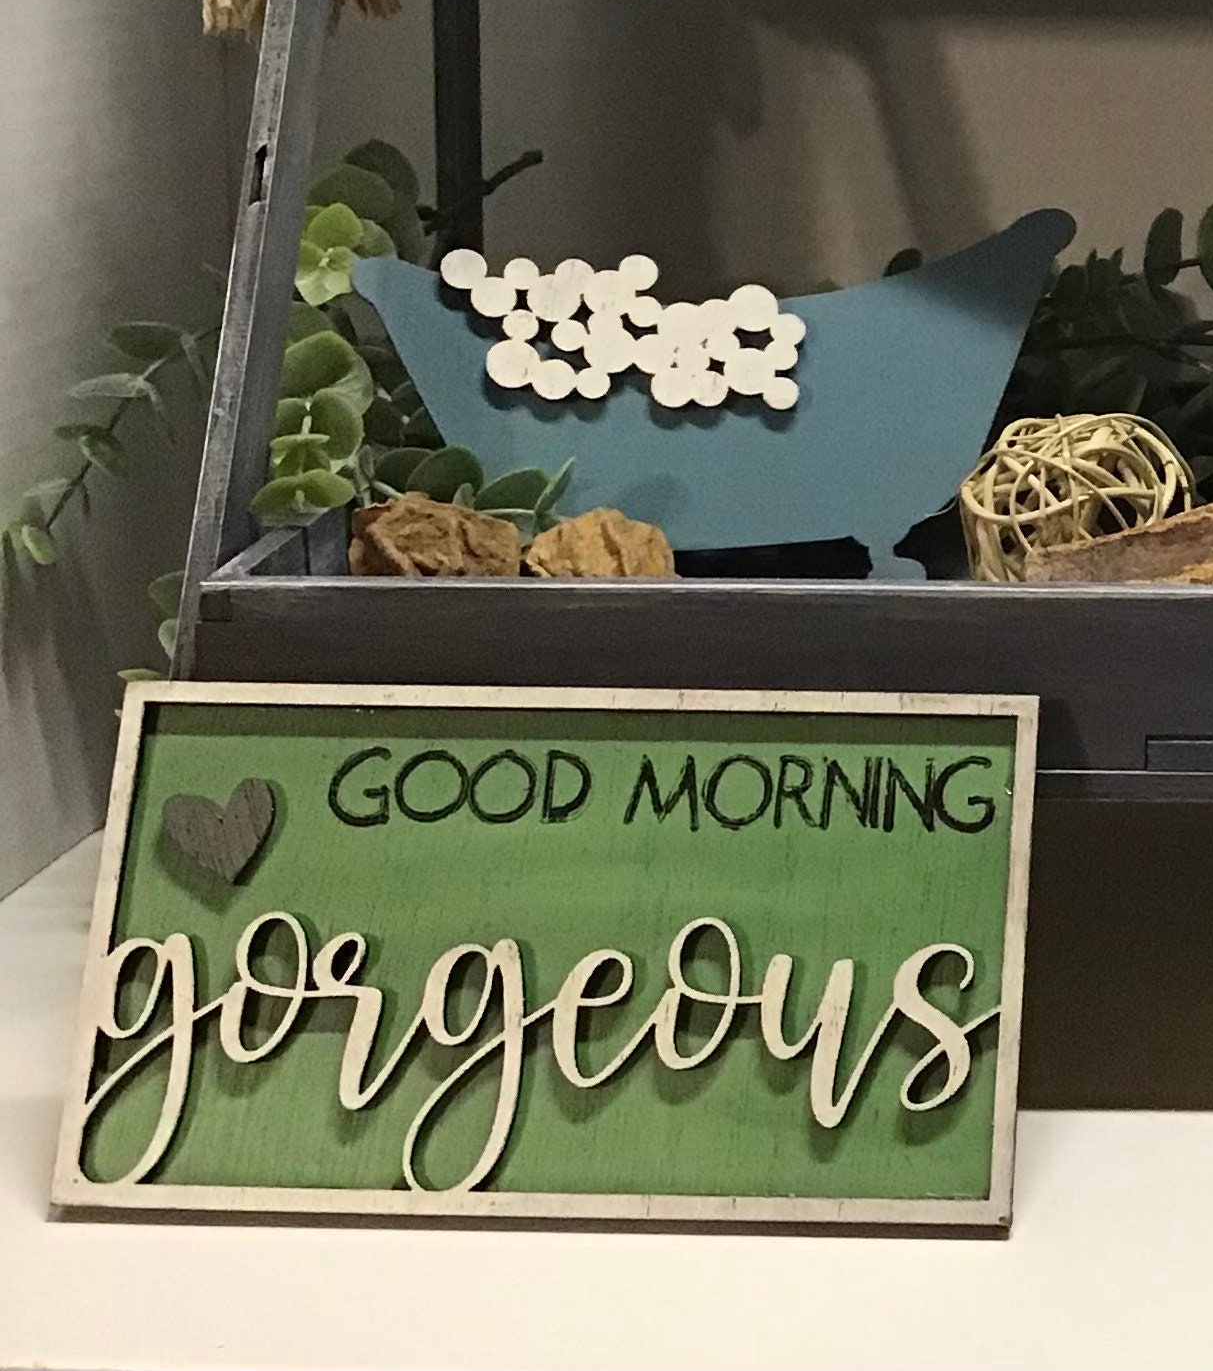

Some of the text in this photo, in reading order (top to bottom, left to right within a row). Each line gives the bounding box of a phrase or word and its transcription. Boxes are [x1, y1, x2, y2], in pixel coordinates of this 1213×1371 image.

[326, 746, 997, 835] GOOD MORNING
[78, 910, 1001, 1194] gorgeous
